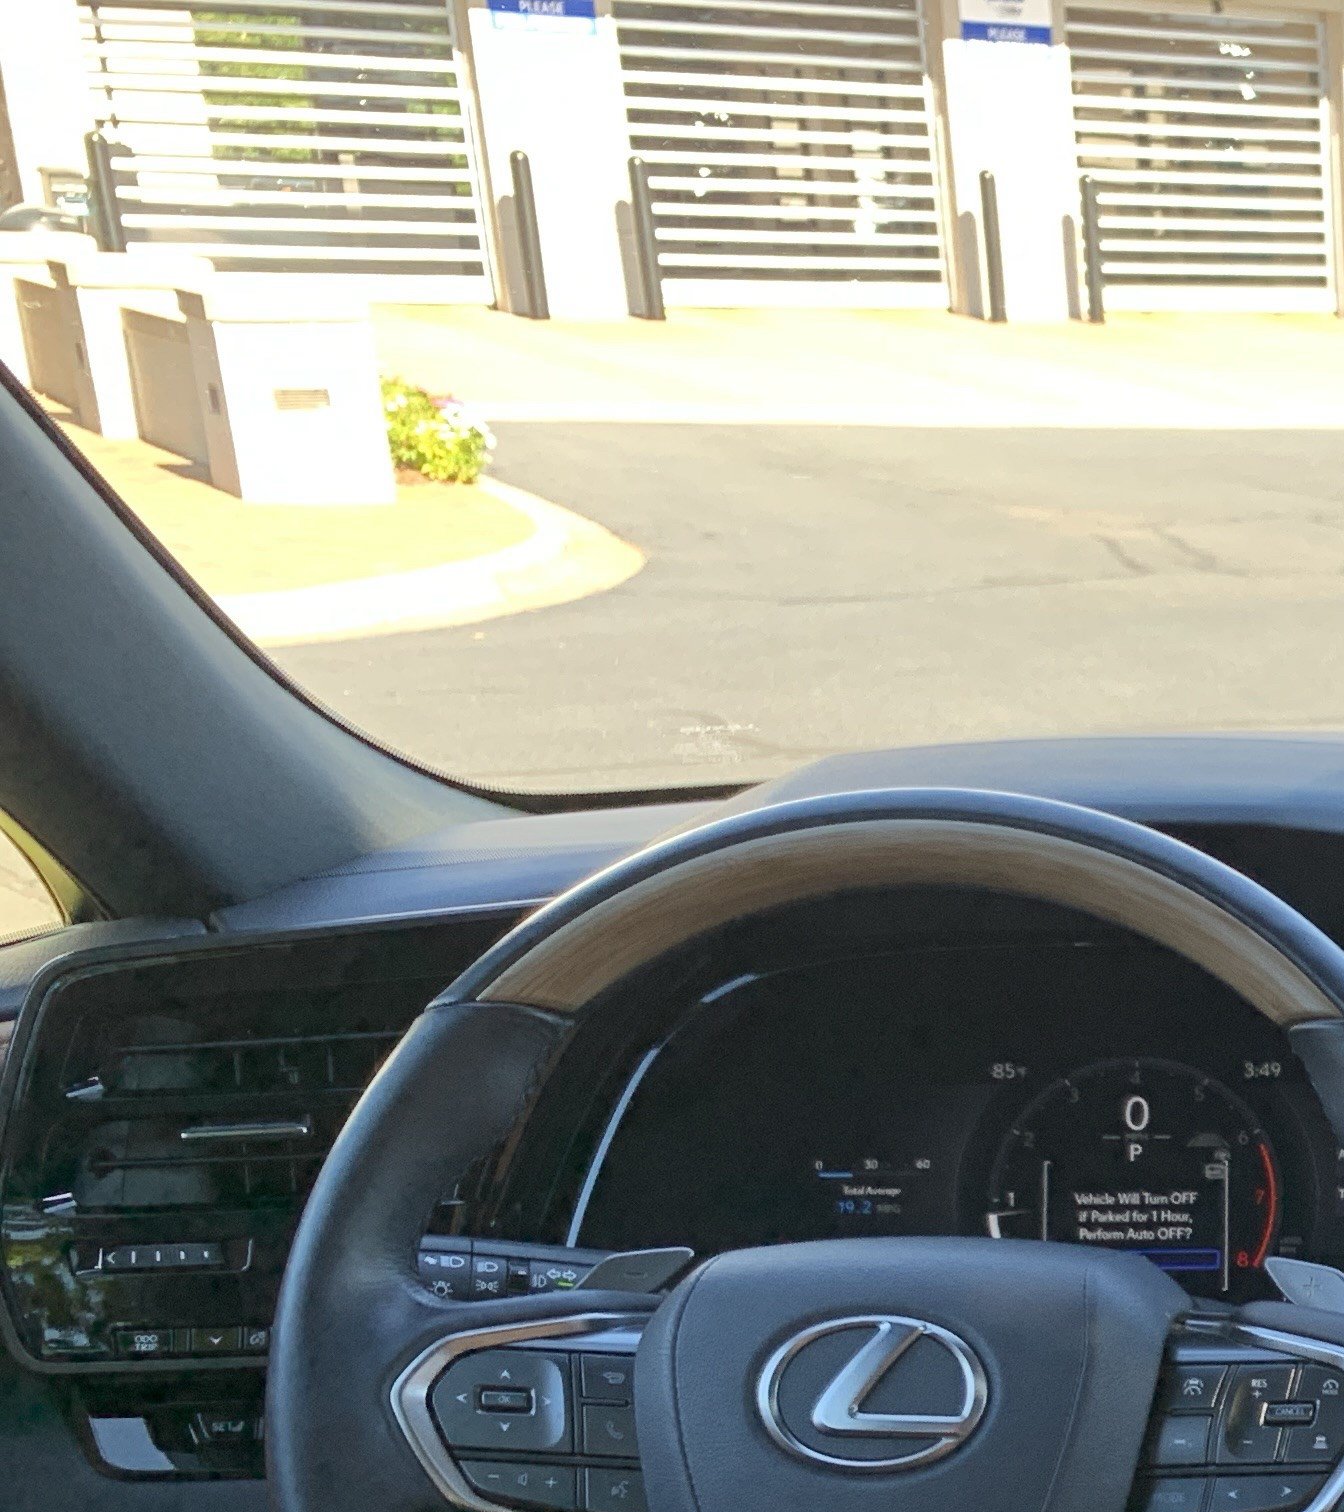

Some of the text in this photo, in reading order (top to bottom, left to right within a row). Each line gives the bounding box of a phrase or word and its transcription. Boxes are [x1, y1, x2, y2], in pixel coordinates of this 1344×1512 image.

[1244, 1061, 1282, 1079] 3:49
[1124, 1095, 1150, 1131] 0
[1129, 1143, 1143, 1162] P
[1074, 1191, 1198, 1205] Vehicle Will Turn OFF
[1090, 1209, 1130, 1222] Parked
[1131, 1209, 1149, 1222] for
[1079, 1227, 1193, 1240] Perform Auto OFF?
